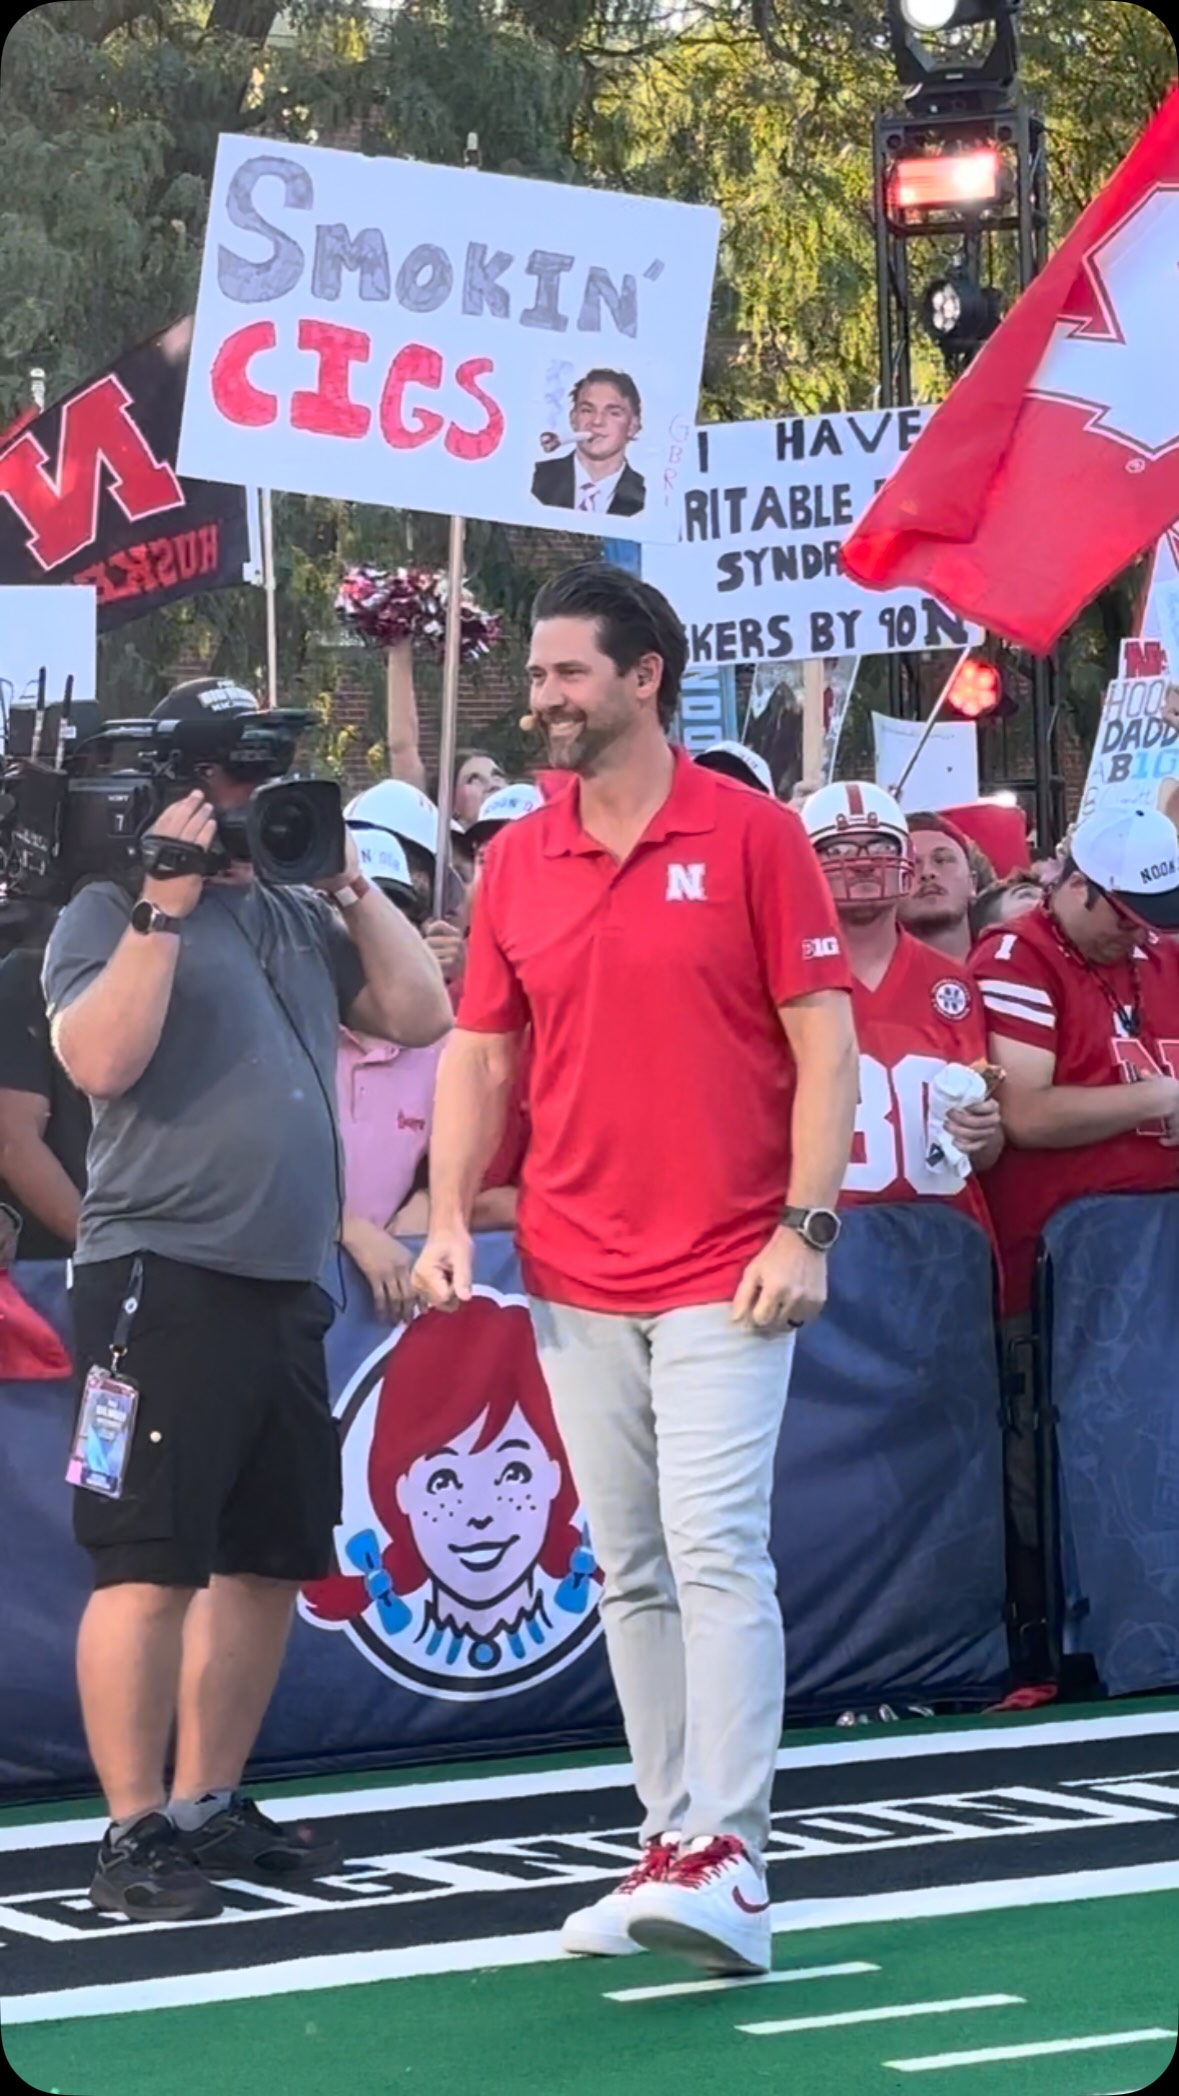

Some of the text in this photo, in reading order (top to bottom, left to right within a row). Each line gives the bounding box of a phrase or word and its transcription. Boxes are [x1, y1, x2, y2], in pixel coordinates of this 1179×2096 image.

[211, 319, 504, 460] CIGS
[697, 409, 921, 473] I HAVE
[679, 483, 853, 543] RITABLE
[684, 614, 793, 663] KERS
[810, 610, 862, 653] BY
[666, 863, 708, 901] N
[995, 935, 1015, 960] 1
